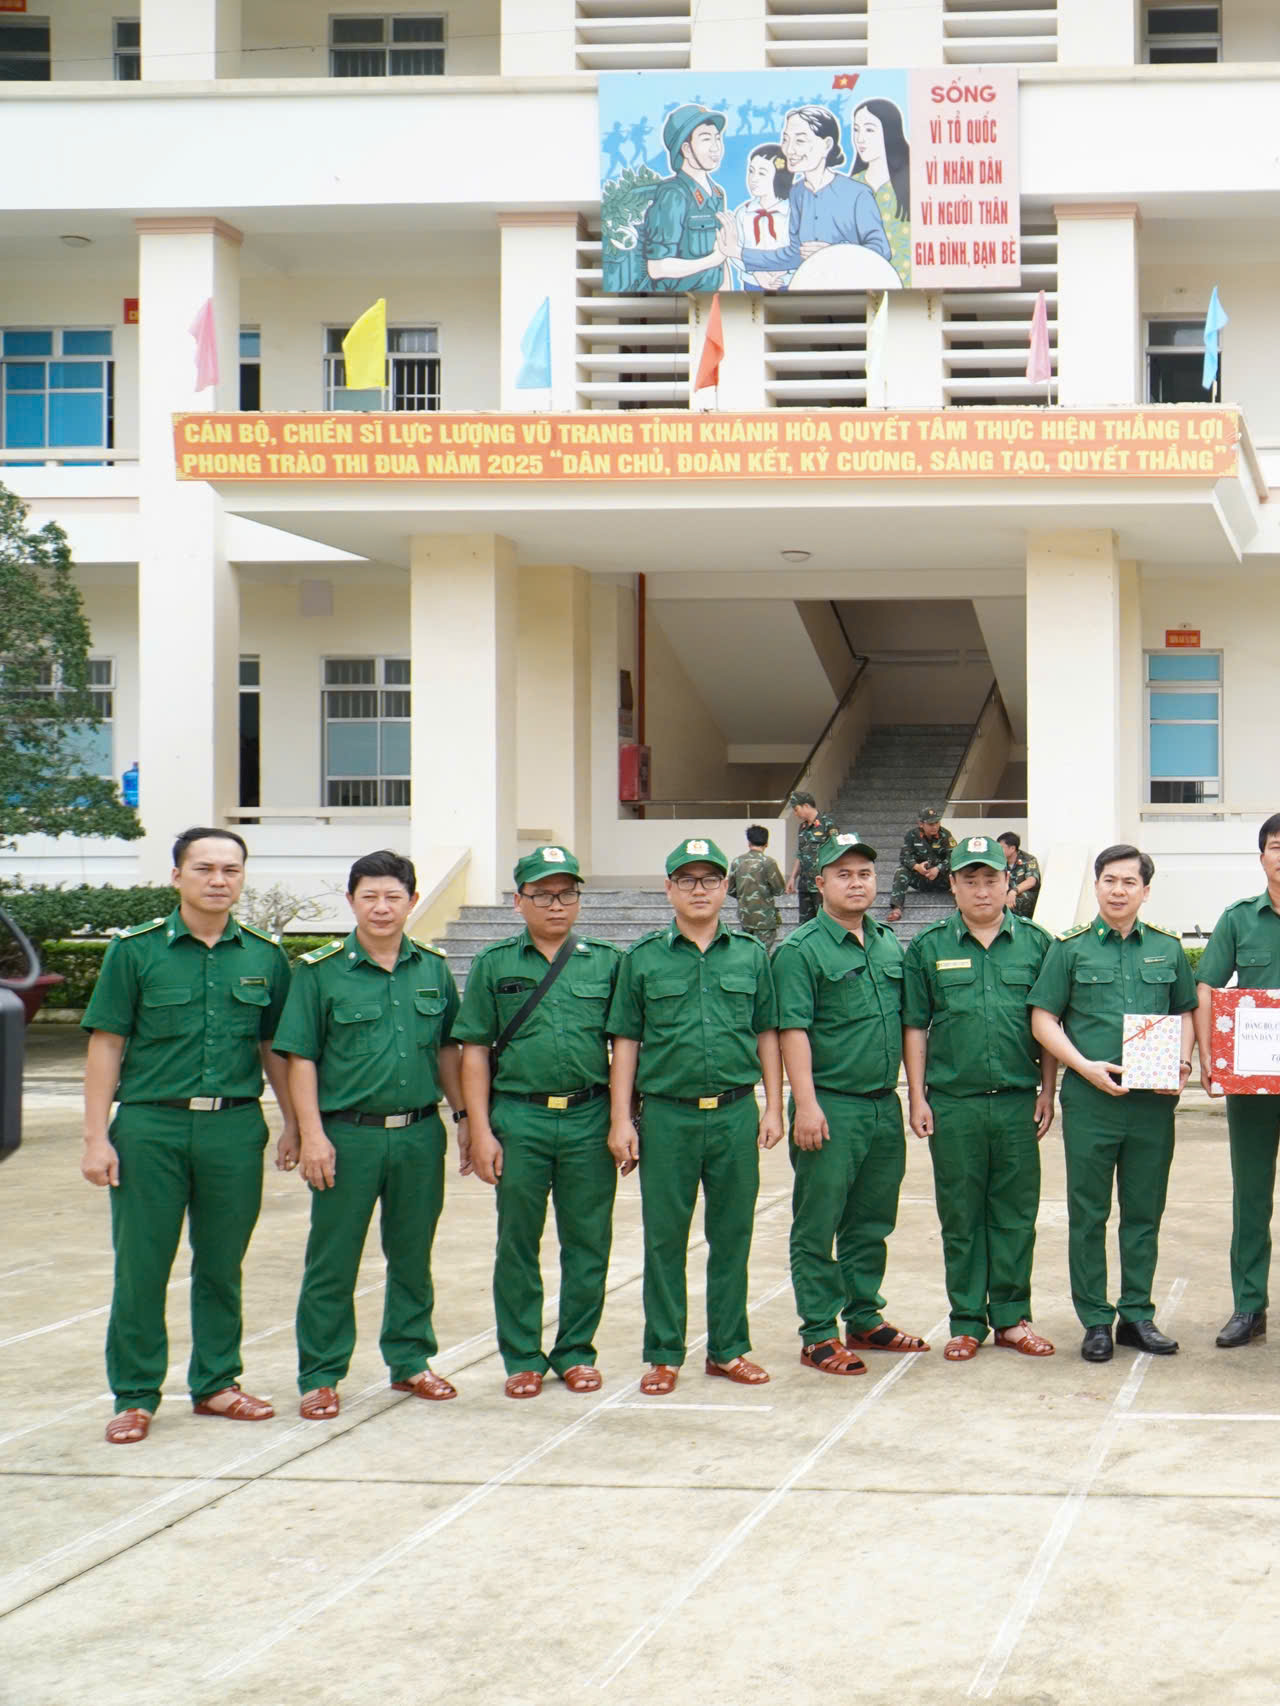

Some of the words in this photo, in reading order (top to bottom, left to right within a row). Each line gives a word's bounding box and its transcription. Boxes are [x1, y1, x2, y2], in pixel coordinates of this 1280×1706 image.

[931, 76, 996, 103] SỐNG
[930, 115, 942, 144] VÌ
[967, 111, 997, 145] QUỐC
[926, 156, 938, 184] VÌ
[943, 156, 974, 184] NHÂN
[979, 156, 1003, 184] DÂN
[921, 196, 933, 225] VÌ
[938, 194, 973, 225] NGƯỜI
[978, 197, 1008, 225] THÂN
[915, 241, 935, 266] GIA
[939, 236, 970, 268] ĐÌNH,
[974, 240, 996, 269] BẠN
[1002, 235, 1016, 265] BÈ
[184, 420, 232, 443] CÁN
[238, 420, 277, 447] BỘ,
[283, 418, 352, 443] CHIẾN
[359, 420, 383, 443] SĨ
[389, 422, 433, 448] LỰC
[440, 422, 515, 448] LƯỢNG
[522, 420, 551, 443] VŨ
[558, 423, 633, 443] TRANG
[640, 417, 692, 443] TỈNH
[700, 419, 778, 442] KHÁNH
[785, 417, 832, 441] HÒA
[840, 415, 911, 443] QUYẾT
[917, 417, 967, 441] TÂM
[974, 419, 1034, 444] THỰC
[1041, 416, 1096, 444] HIỆN
[1103, 411, 1180, 440] THẮNG
[1188, 419, 1223, 444] LỢI
[183, 453, 261, 473] PHONG
[267, 450, 326, 473] TRÀO
[333, 454, 368, 473] THI
[375, 454, 420, 474] ĐUA
[426, 450, 480, 473] NĂM
[488, 454, 543, 474] 2025
[618, 447, 671, 475] CHỦ,
[677, 449, 740, 473] ĐOÀN
[749, 446, 793, 474] KẾT,
[800, 446, 830, 472] KỶ
[837, 449, 922, 473] CƯƠNG,
[930, 447, 993, 471] SÁNG
[1001, 450, 1050, 474] TẠO,
[1058, 444, 1130, 472] QUYẾT
